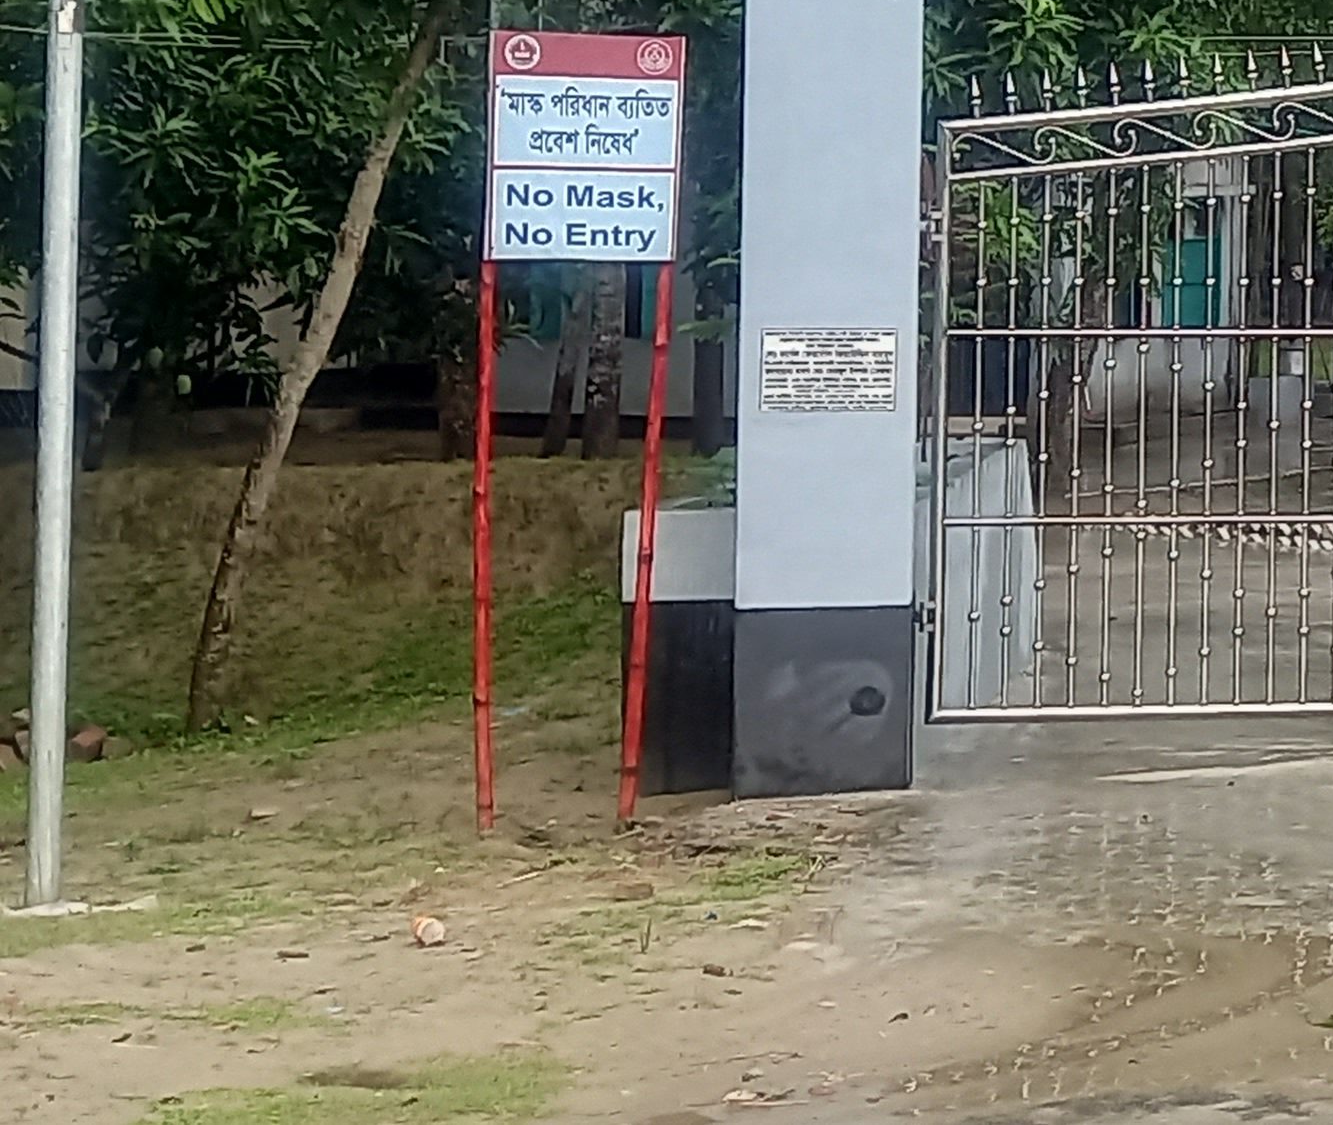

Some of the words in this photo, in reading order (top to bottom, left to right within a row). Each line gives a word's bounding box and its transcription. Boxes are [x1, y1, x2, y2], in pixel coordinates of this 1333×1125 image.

[551, 86, 612, 117] পরিধান
[616, 88, 672, 119] ব্যতিত
[529, 129, 579, 154] প্রবেশ
[505, 183, 554, 207] No
[566, 185, 664, 212] Mask,
[505, 223, 553, 246] No
[566, 224, 656, 253] Entry
